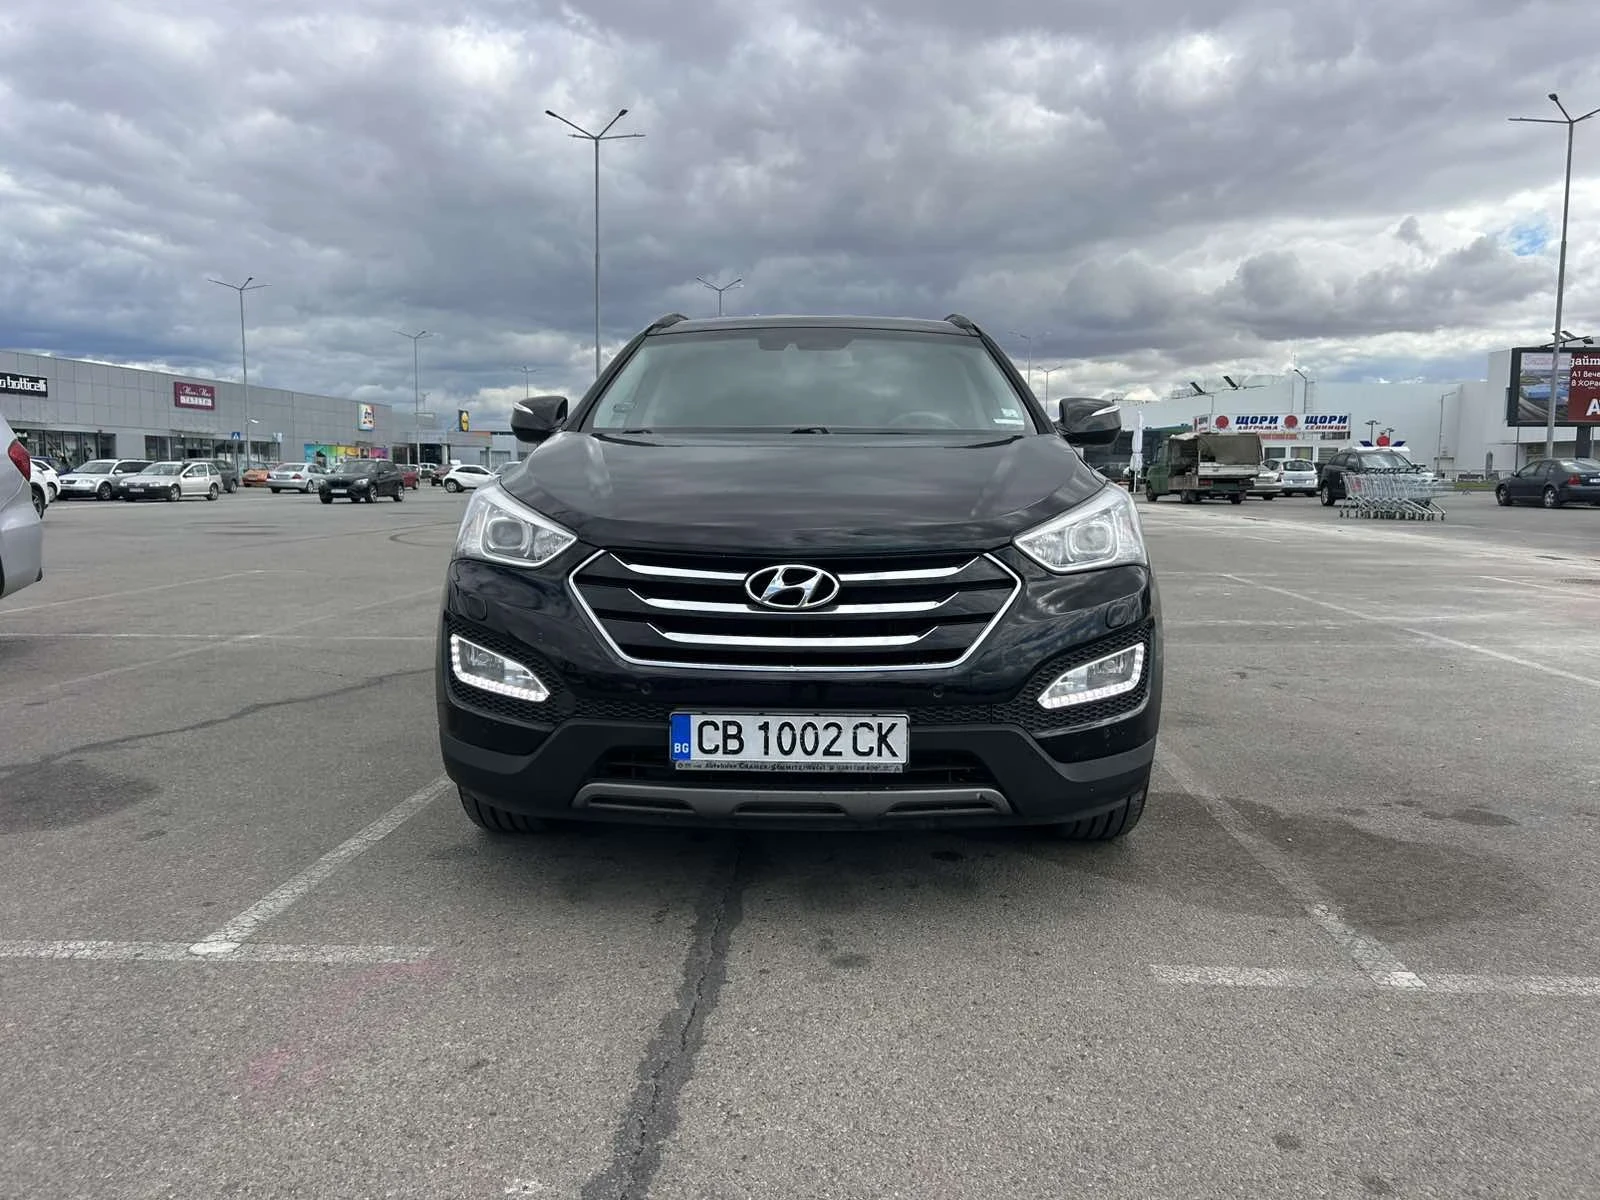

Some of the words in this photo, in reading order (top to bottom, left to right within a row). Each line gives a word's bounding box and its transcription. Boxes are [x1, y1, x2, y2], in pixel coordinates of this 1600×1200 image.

[7, 376, 46, 392] botticelli
[1235, 416, 1279, 425] ЩОРИ
[1304, 415, 1348, 425] ЩОРИ
[697, 720, 744, 755] CB
[758, 721, 843, 756] 1002
[852, 722, 898, 757] CK
[674, 743, 689, 753] BG
